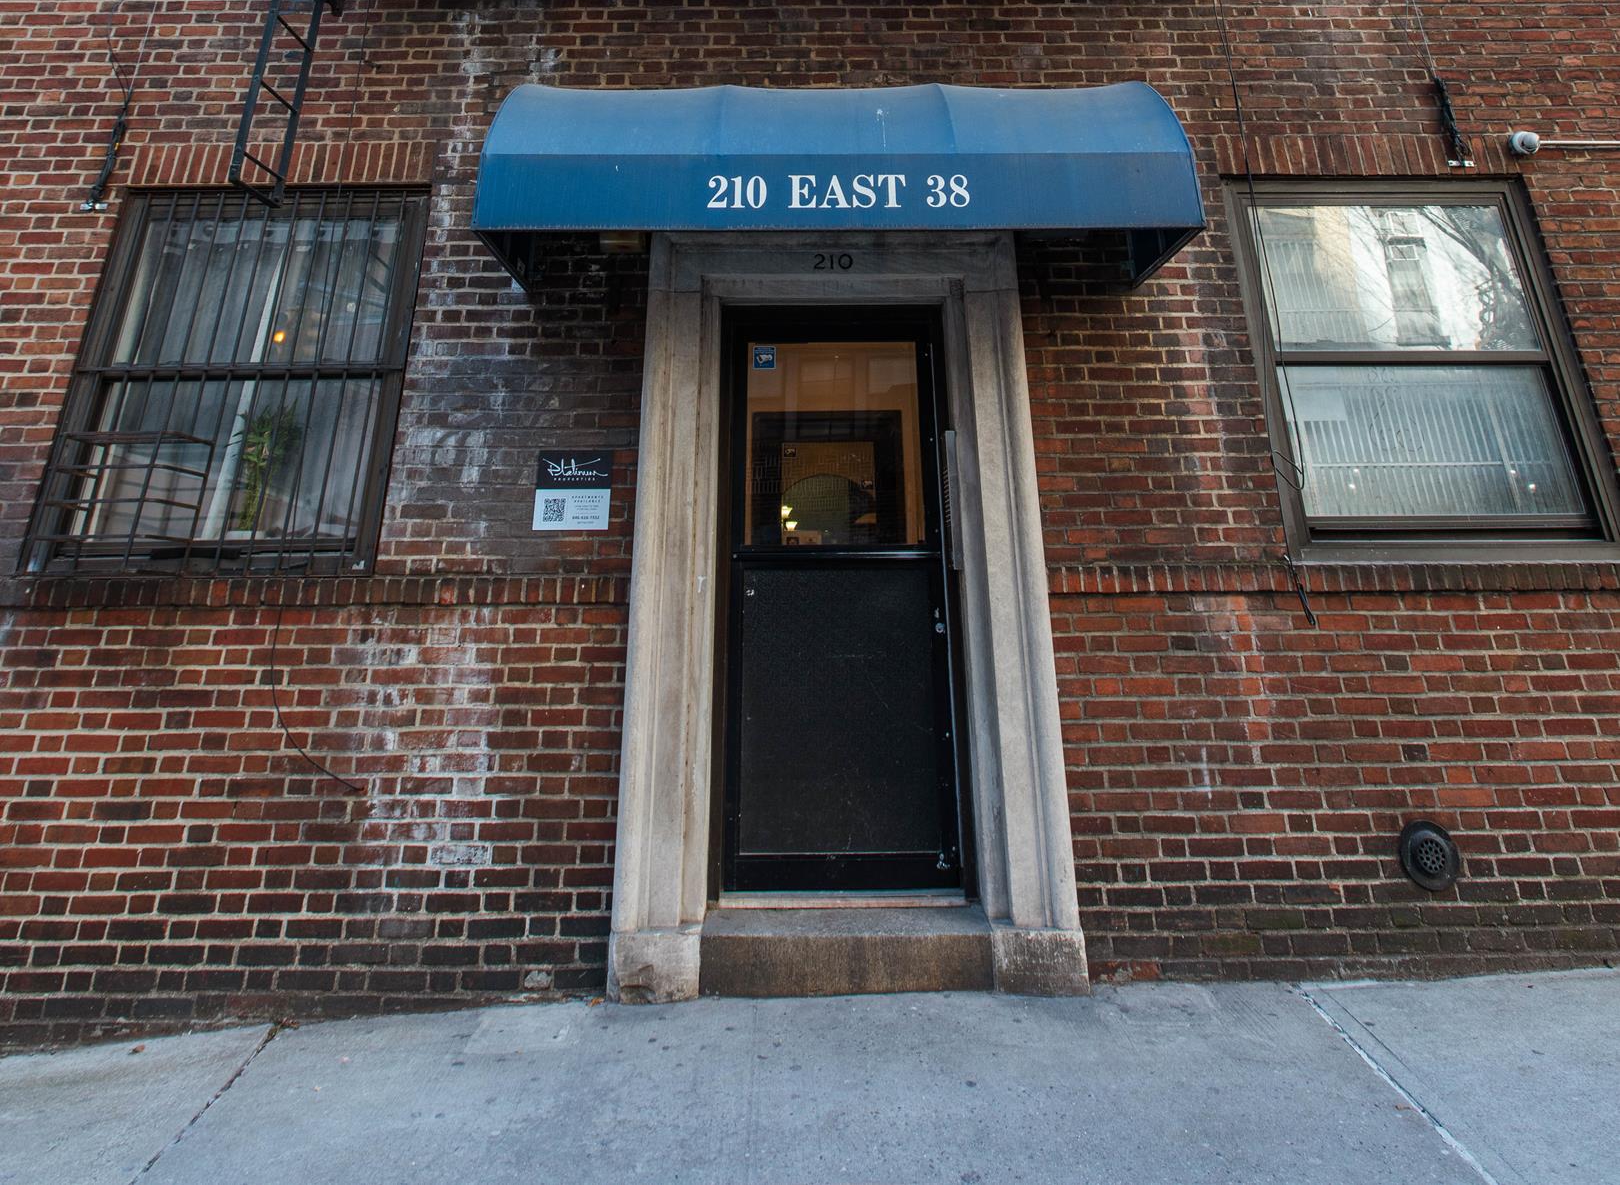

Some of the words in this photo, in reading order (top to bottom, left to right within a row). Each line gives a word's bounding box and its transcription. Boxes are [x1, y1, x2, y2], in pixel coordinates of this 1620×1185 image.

[706, 175, 767, 209] 210
[787, 174, 906, 208] EAST
[926, 174, 970, 208] 38
[813, 253, 853, 270] 210
